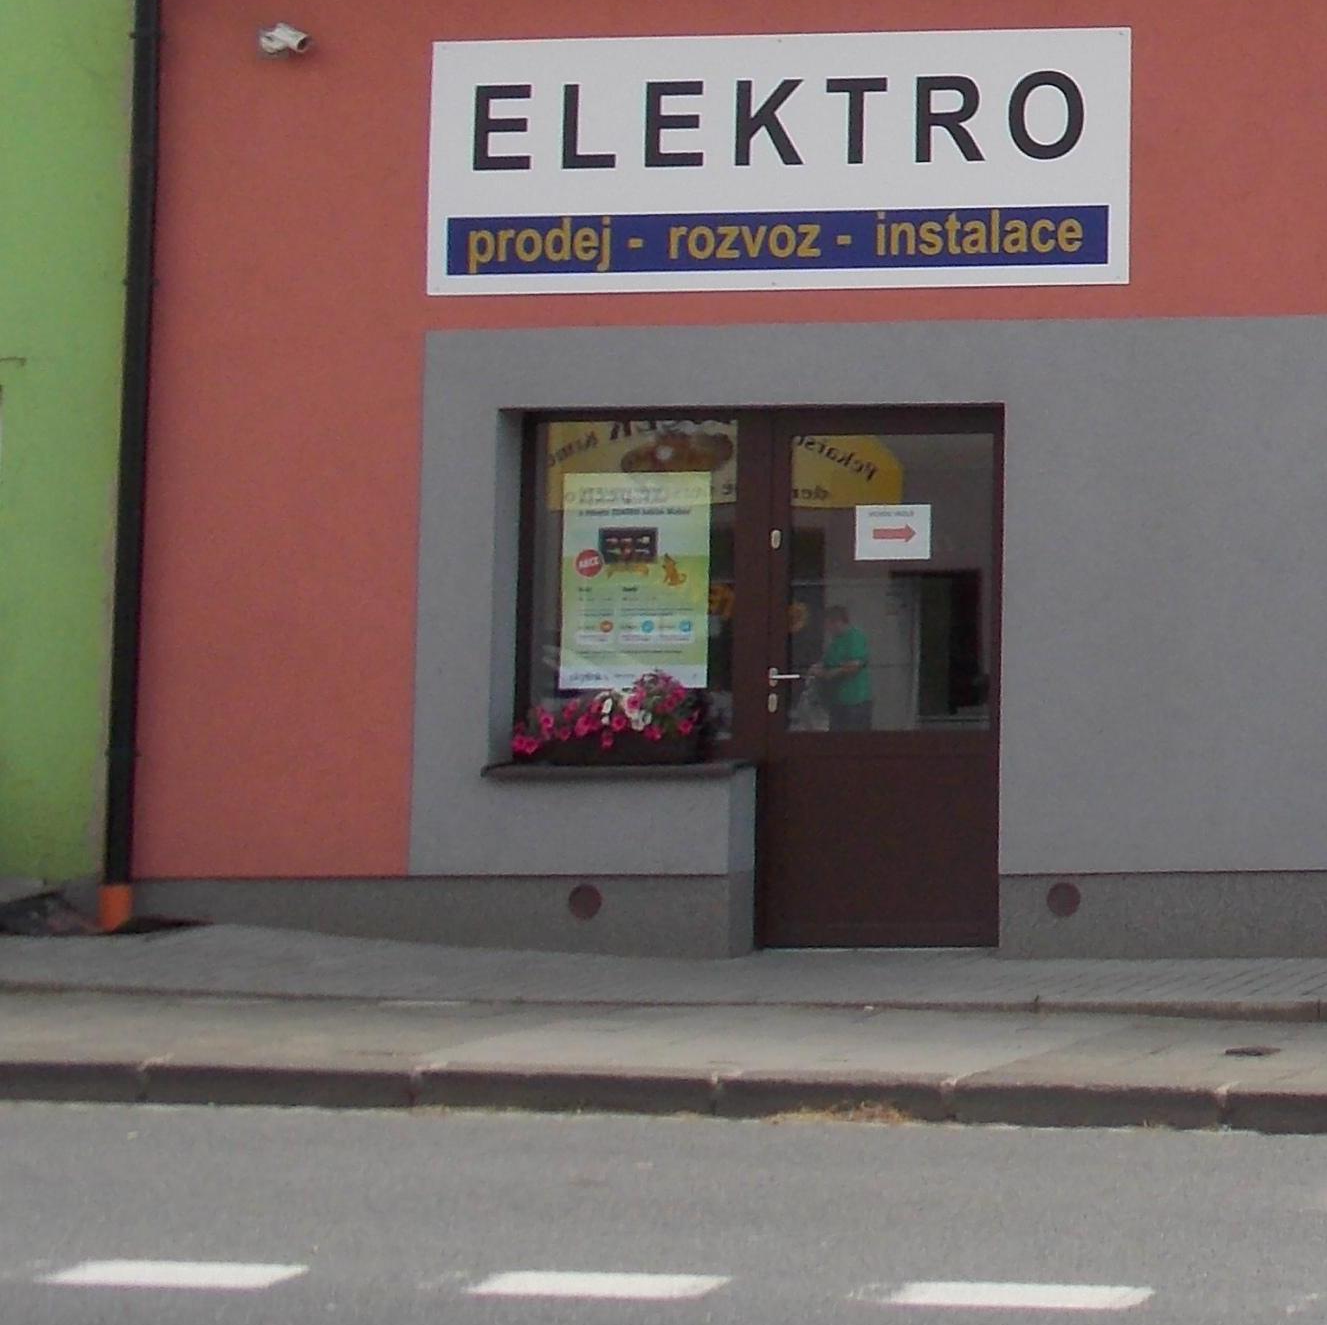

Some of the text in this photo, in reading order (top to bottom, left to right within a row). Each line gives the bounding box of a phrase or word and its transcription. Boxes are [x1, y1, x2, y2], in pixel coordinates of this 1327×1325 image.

[472, 70, 1085, 172] ELEKTRO
[466, 217, 612, 275] prodej
[667, 224, 821, 261] rozvoz
[874, 209, 1083, 257] instalace
